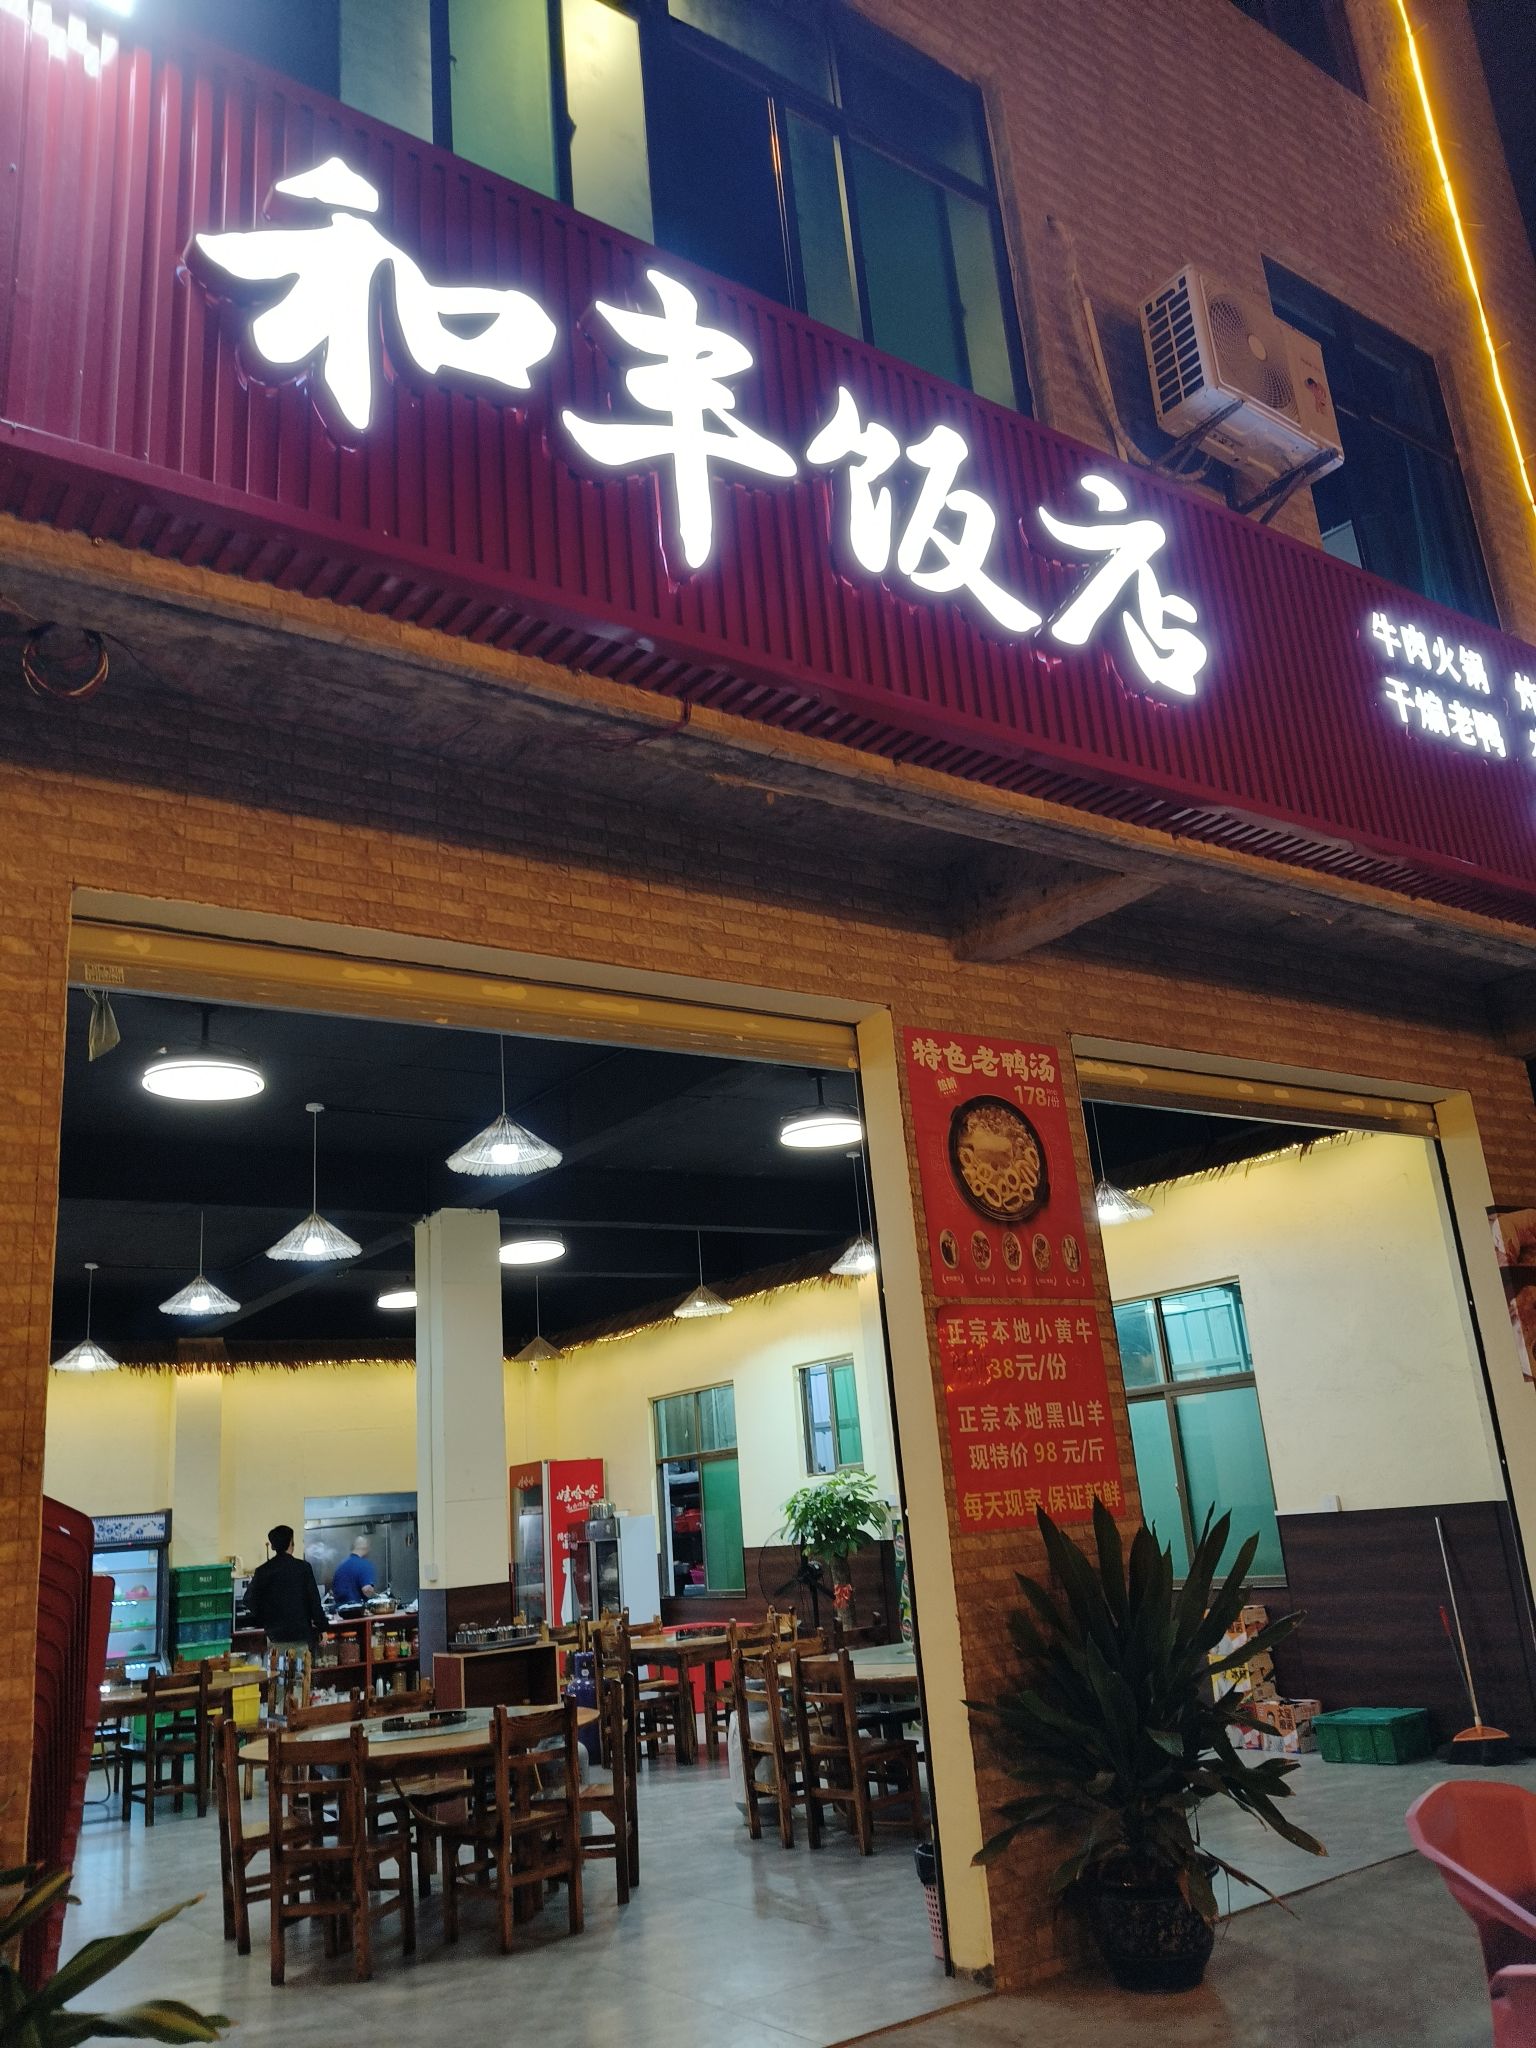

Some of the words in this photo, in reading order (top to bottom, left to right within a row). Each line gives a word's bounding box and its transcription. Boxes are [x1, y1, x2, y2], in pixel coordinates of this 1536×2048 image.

[196, 157, 1207, 695] 和丰饭店
[1372, 611, 1491, 695] 牛肉火锅
[912, 1037, 1056, 1084] 特色老鸭汤
[946, 1317, 1094, 1346] 正宗本地小黄牛
[957, 1399, 1106, 1434] 正宗本地黑山羊
